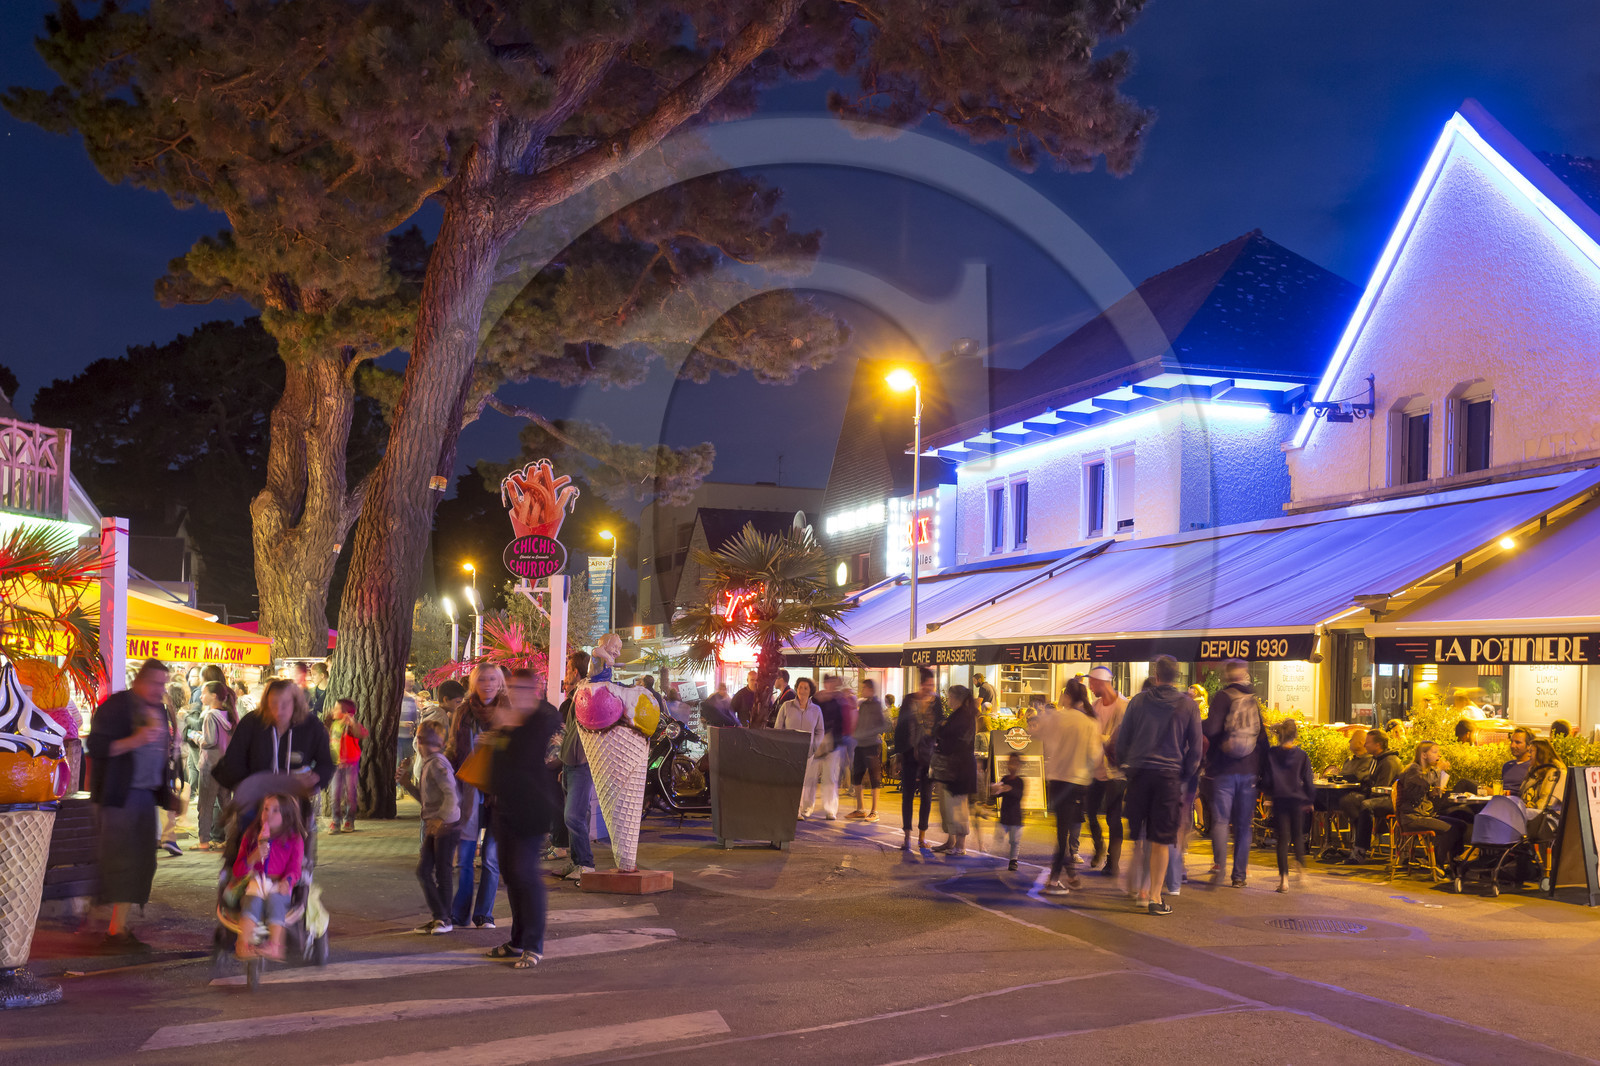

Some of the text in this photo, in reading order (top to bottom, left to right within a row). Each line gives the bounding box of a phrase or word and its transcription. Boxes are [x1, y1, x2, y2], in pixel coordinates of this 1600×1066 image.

[905, 516, 929, 546] RX
[513, 537, 556, 554] CHICHIS
[510, 560, 559, 577] CHURROS
[912, 649, 977, 663] CAFE BRASSERIE
[1023, 643, 1092, 662] LA POTINIERE
[1200, 638, 1289, 658] DEPUIS 1930
[1434, 636, 1589, 662] LA POTINIERE
[1536, 674, 1559, 684] LUNCH
[1536, 686, 1558, 696] SNACK
[1534, 698, 1559, 708] DINNER
